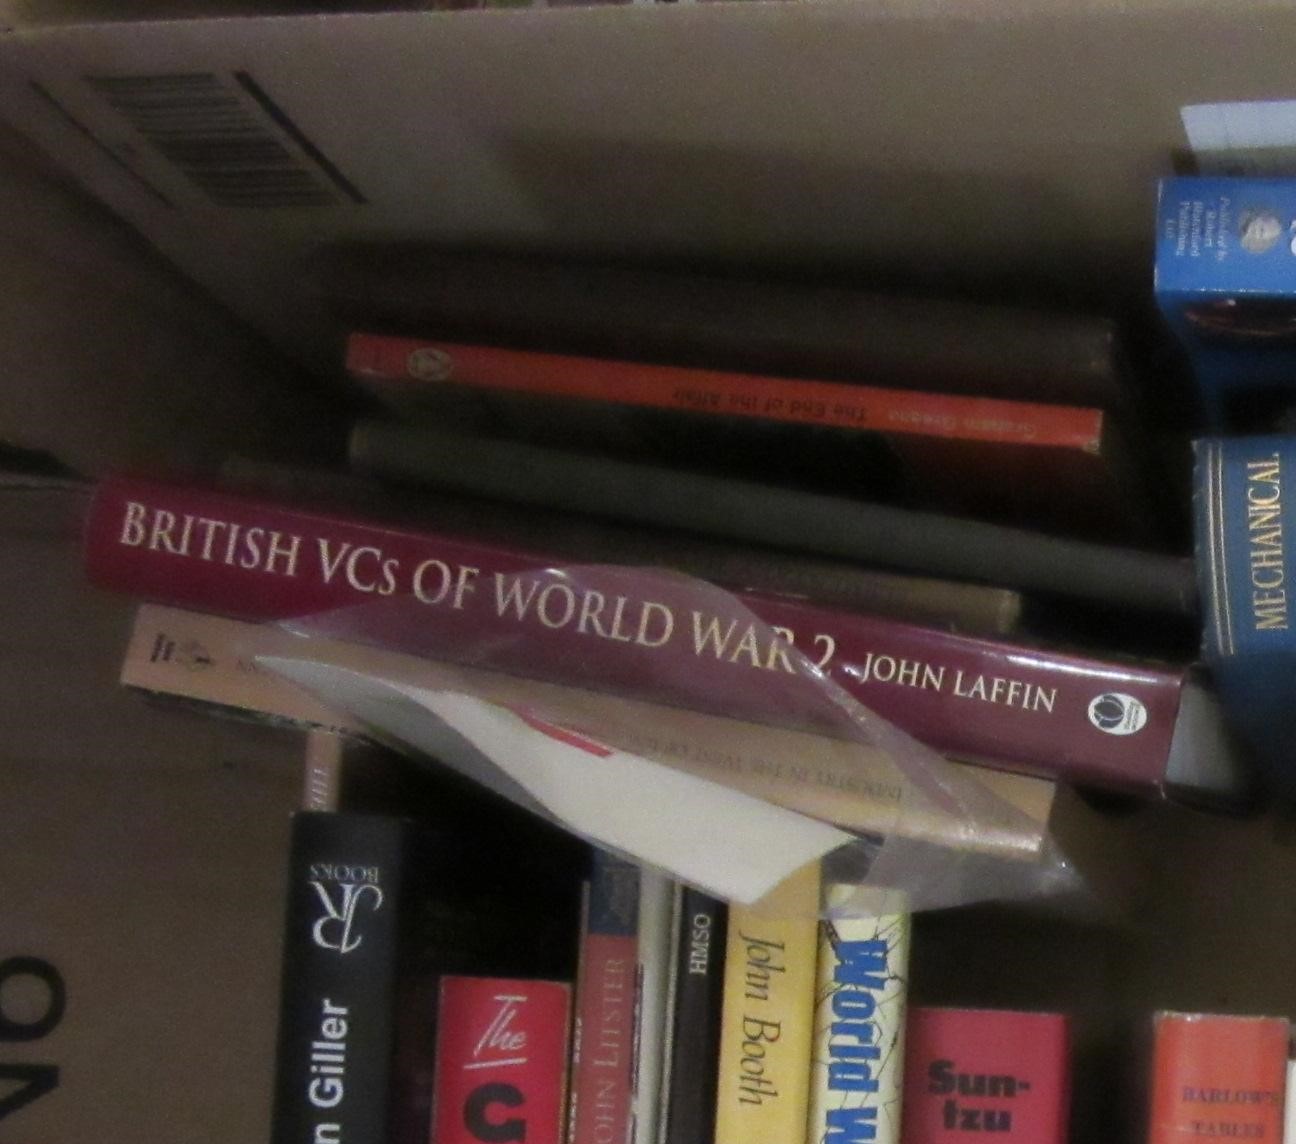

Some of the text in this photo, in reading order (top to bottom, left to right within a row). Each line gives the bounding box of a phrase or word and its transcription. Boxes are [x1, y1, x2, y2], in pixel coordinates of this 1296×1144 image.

[1247, 452, 1289, 631] MECHANICAL
[120, 501, 1057, 712] BRITISH VCs OF WORLD WAR 2 JOHN LAFFIN
[310, 864, 379, 882] BOOKS
[689, 913, 711, 975] HMSO
[308, 998, 350, 1107] Giller
[473, 995, 528, 1057] The
[739, 929, 785, 1108] John Booth
[828, 940, 887, 1094] World
[928, 1060, 1031, 1097] Sun-
[943, 1104, 1011, 1132] tzu
